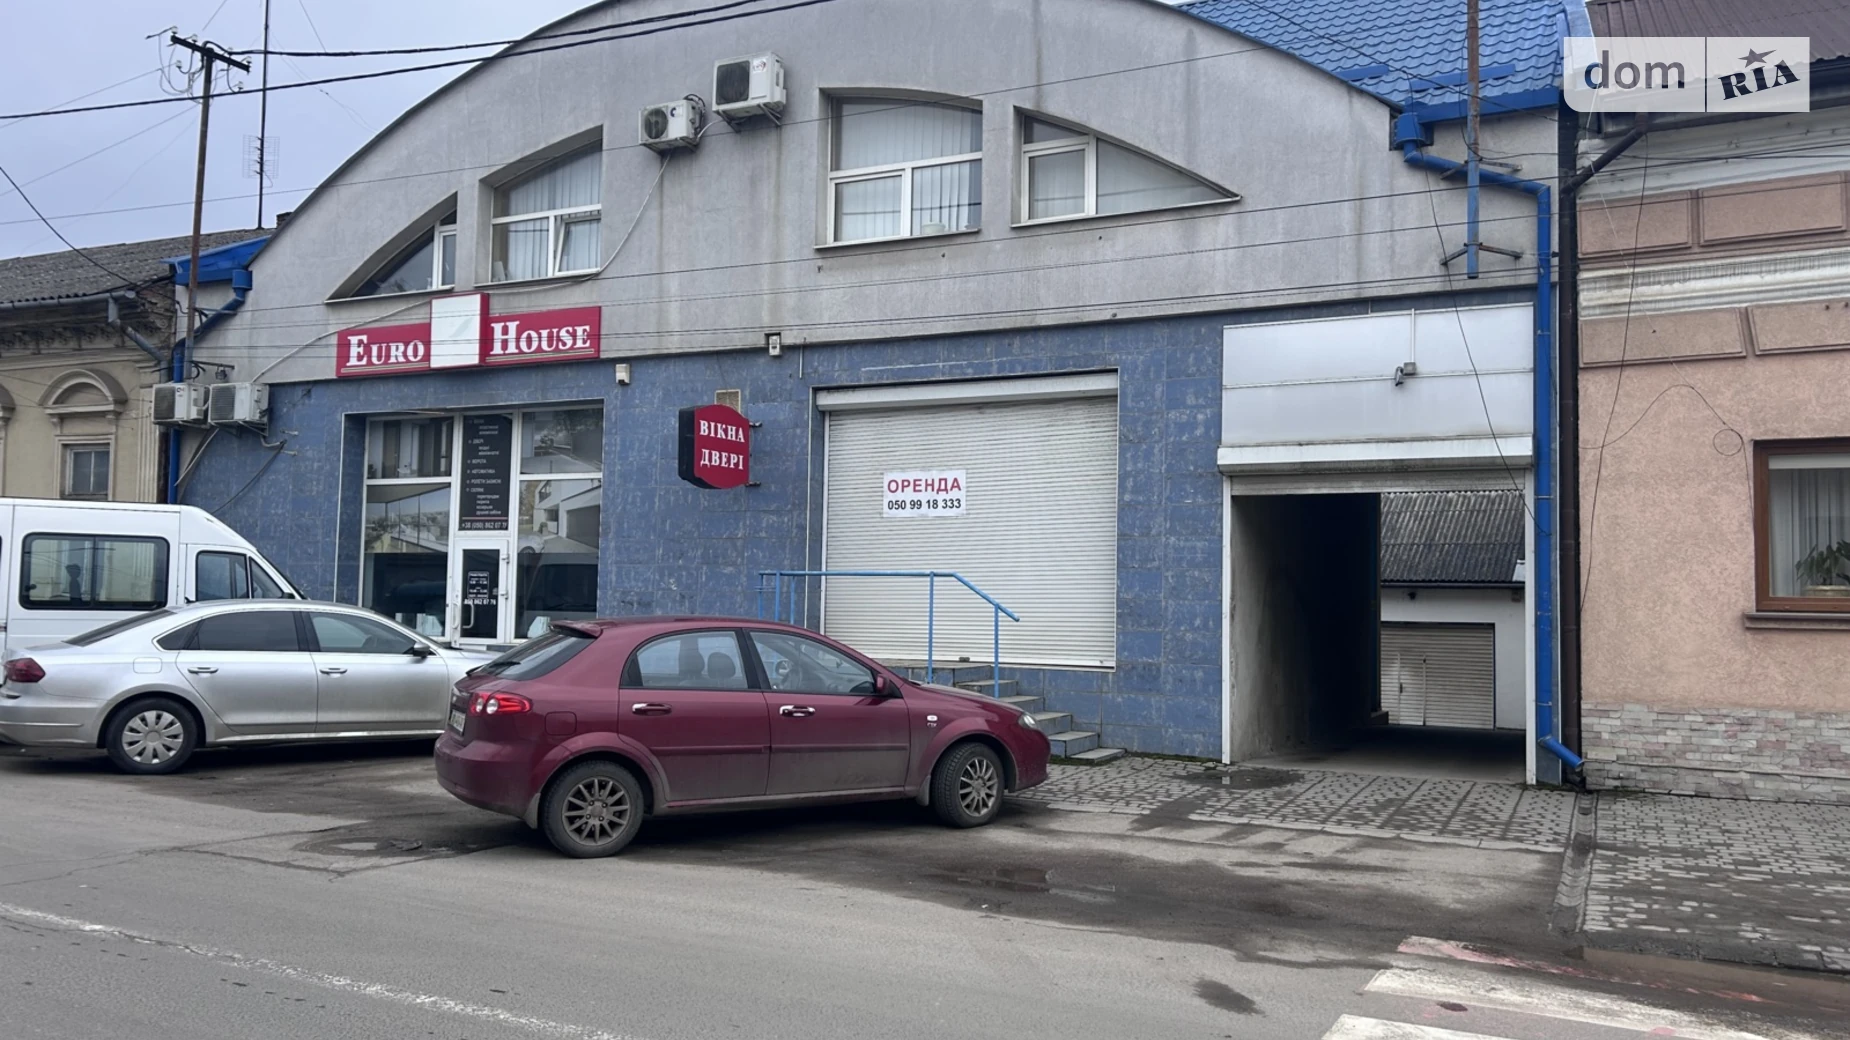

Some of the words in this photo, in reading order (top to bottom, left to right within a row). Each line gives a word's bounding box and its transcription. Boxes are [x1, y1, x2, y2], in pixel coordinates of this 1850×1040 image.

[699, 419, 745, 443] ВІКНА
[700, 448, 744, 470] ДВЕРІ
[887, 477, 962, 495] ОРЕНДА
[887, 499, 907, 510] 050
[909, 499, 923, 510] 99
[926, 498, 939, 510] 18
[941, 498, 962, 509] 333
